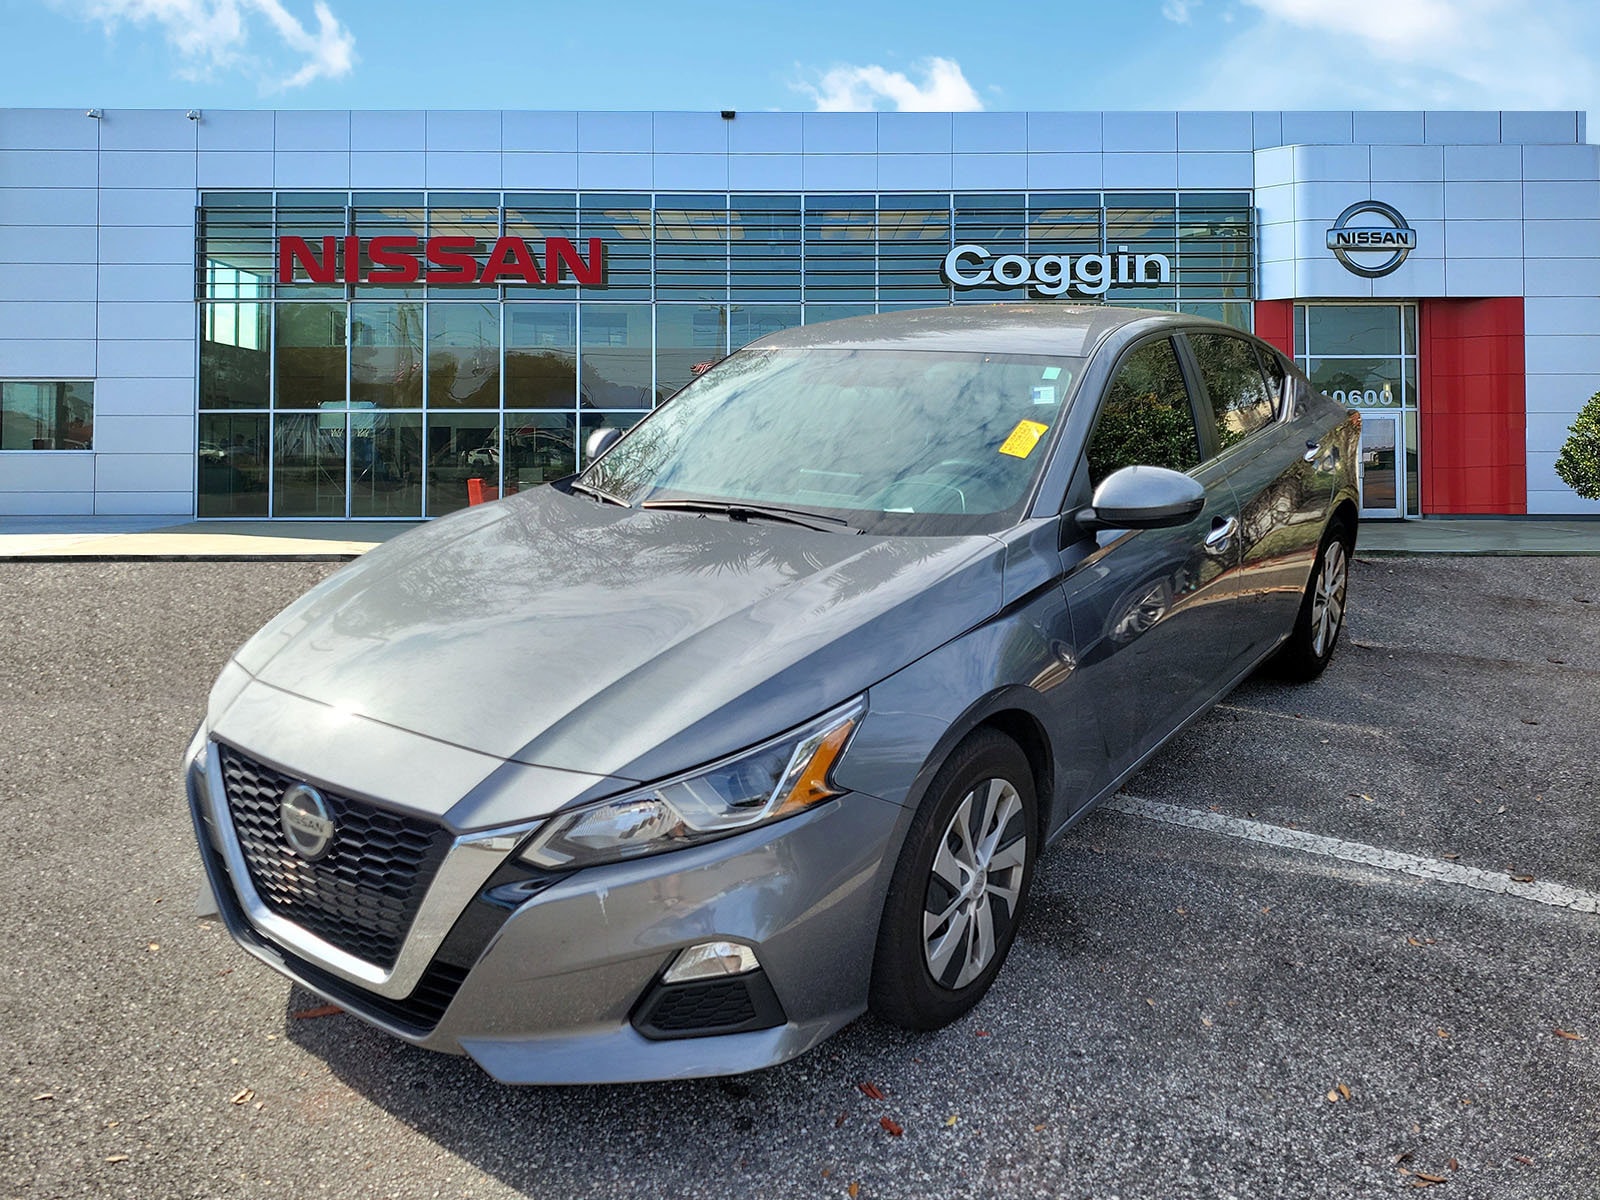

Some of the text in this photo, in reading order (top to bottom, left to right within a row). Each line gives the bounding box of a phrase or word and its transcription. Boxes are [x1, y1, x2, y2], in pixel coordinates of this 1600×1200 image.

[1336, 231, 1409, 245] NISSAN
[279, 236, 603, 285] NISSAN
[944, 244, 1170, 295] Coggin
[286, 810, 325, 834] SSAN
